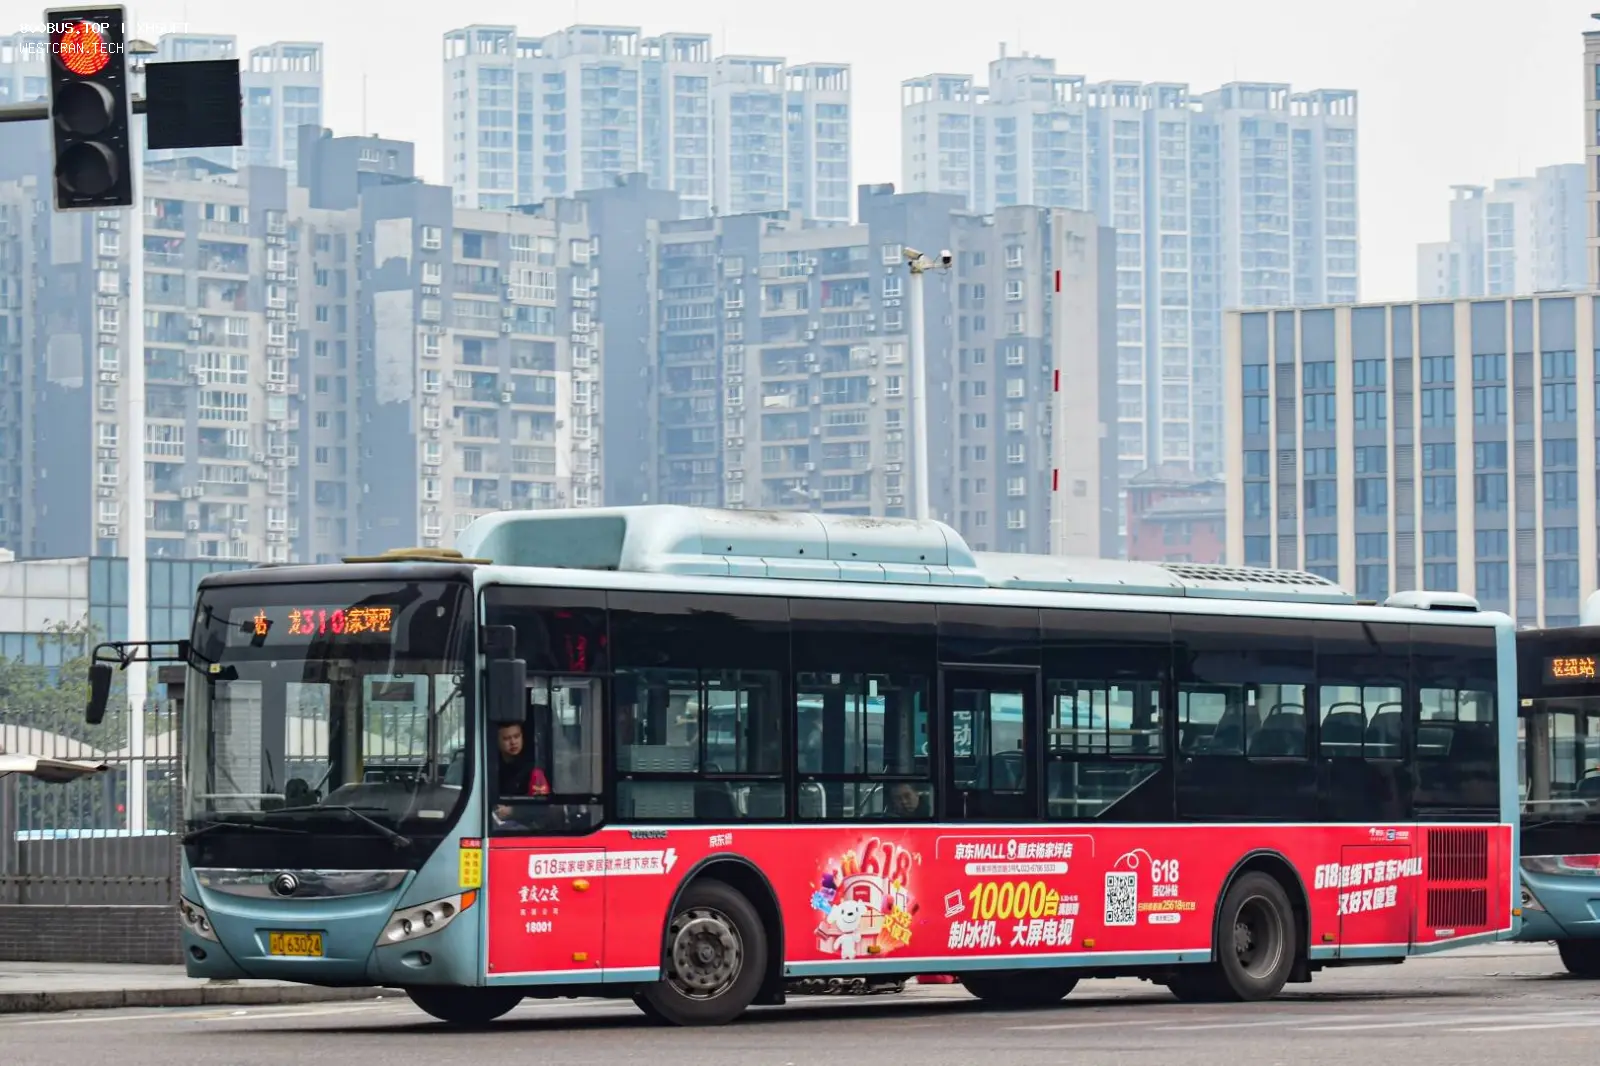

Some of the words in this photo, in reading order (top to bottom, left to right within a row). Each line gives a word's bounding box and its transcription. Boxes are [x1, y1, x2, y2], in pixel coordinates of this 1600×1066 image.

[301, 608, 345, 634] 310
[1151, 859, 1179, 883] 618
[518, 884, 560, 903] 重庆公交
[968, 881, 1060, 920] 10000台
[1337, 885, 1398, 916] 又好又便宜
[525, 921, 552, 933] 18001
